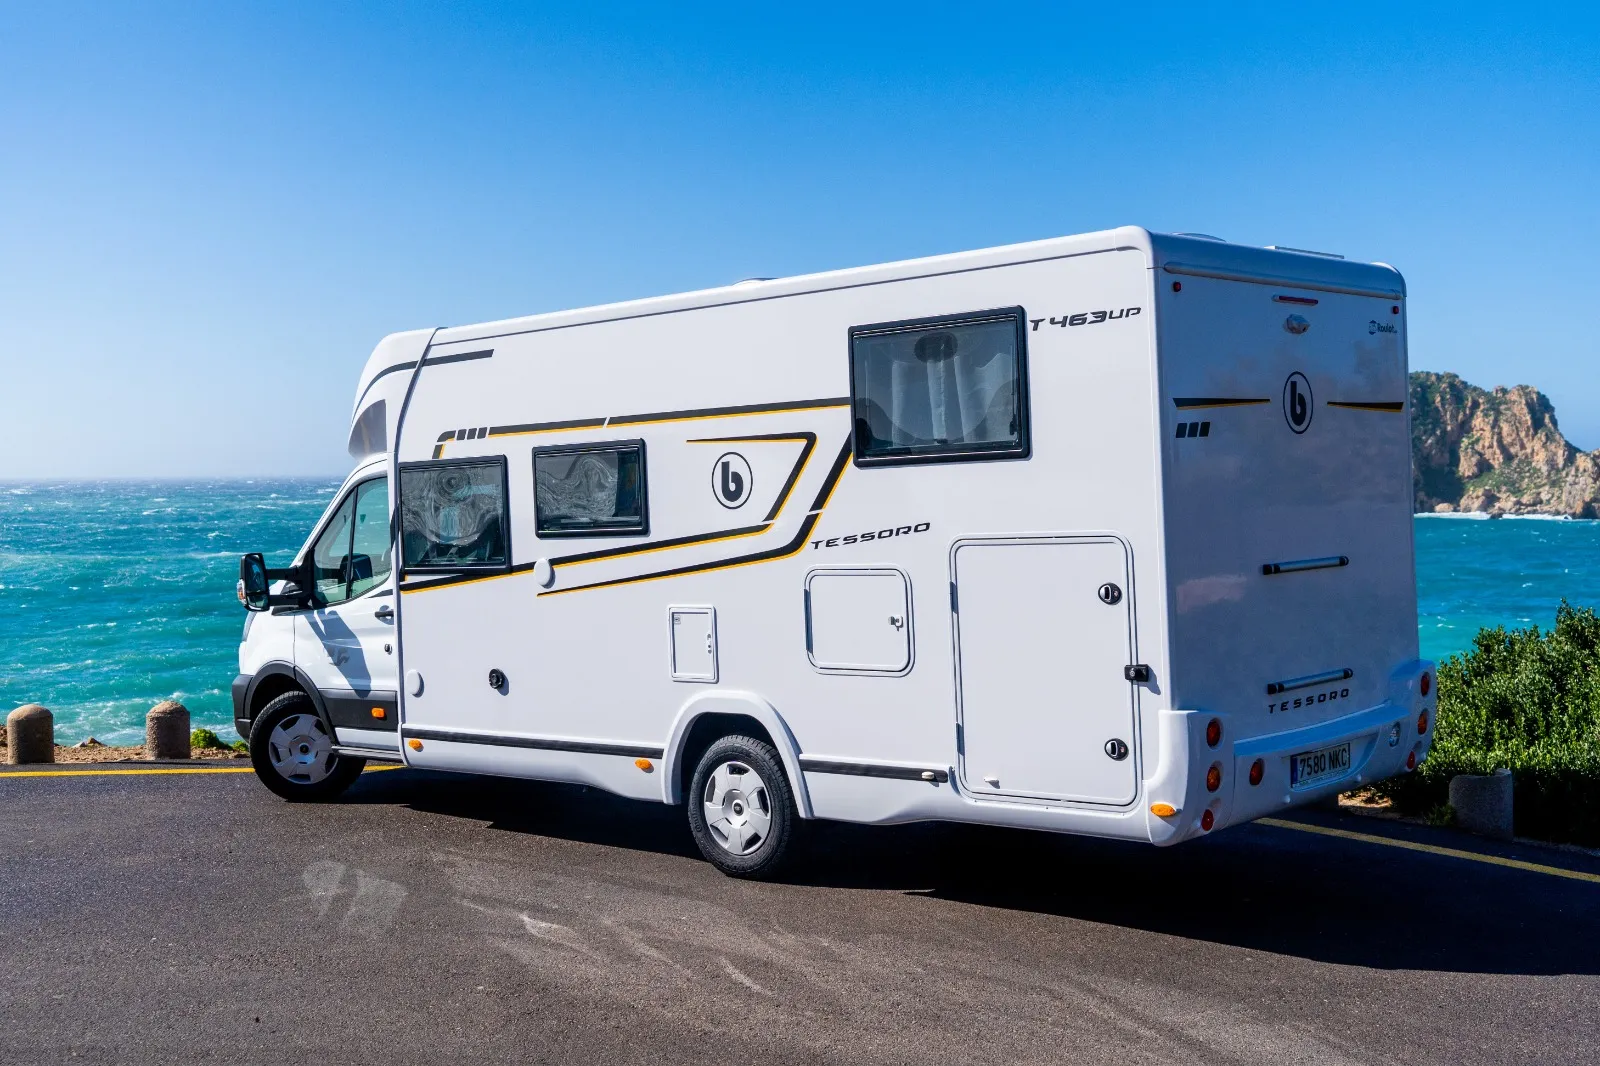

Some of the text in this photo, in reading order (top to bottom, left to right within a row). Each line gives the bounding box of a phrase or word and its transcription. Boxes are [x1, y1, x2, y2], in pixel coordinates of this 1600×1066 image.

[1029, 307, 1142, 332] T 463UP
[811, 522, 931, 550] TESSORO
[1268, 688, 1349, 714] TESSORO
[1299, 747, 1348, 778] 7580 NKC
